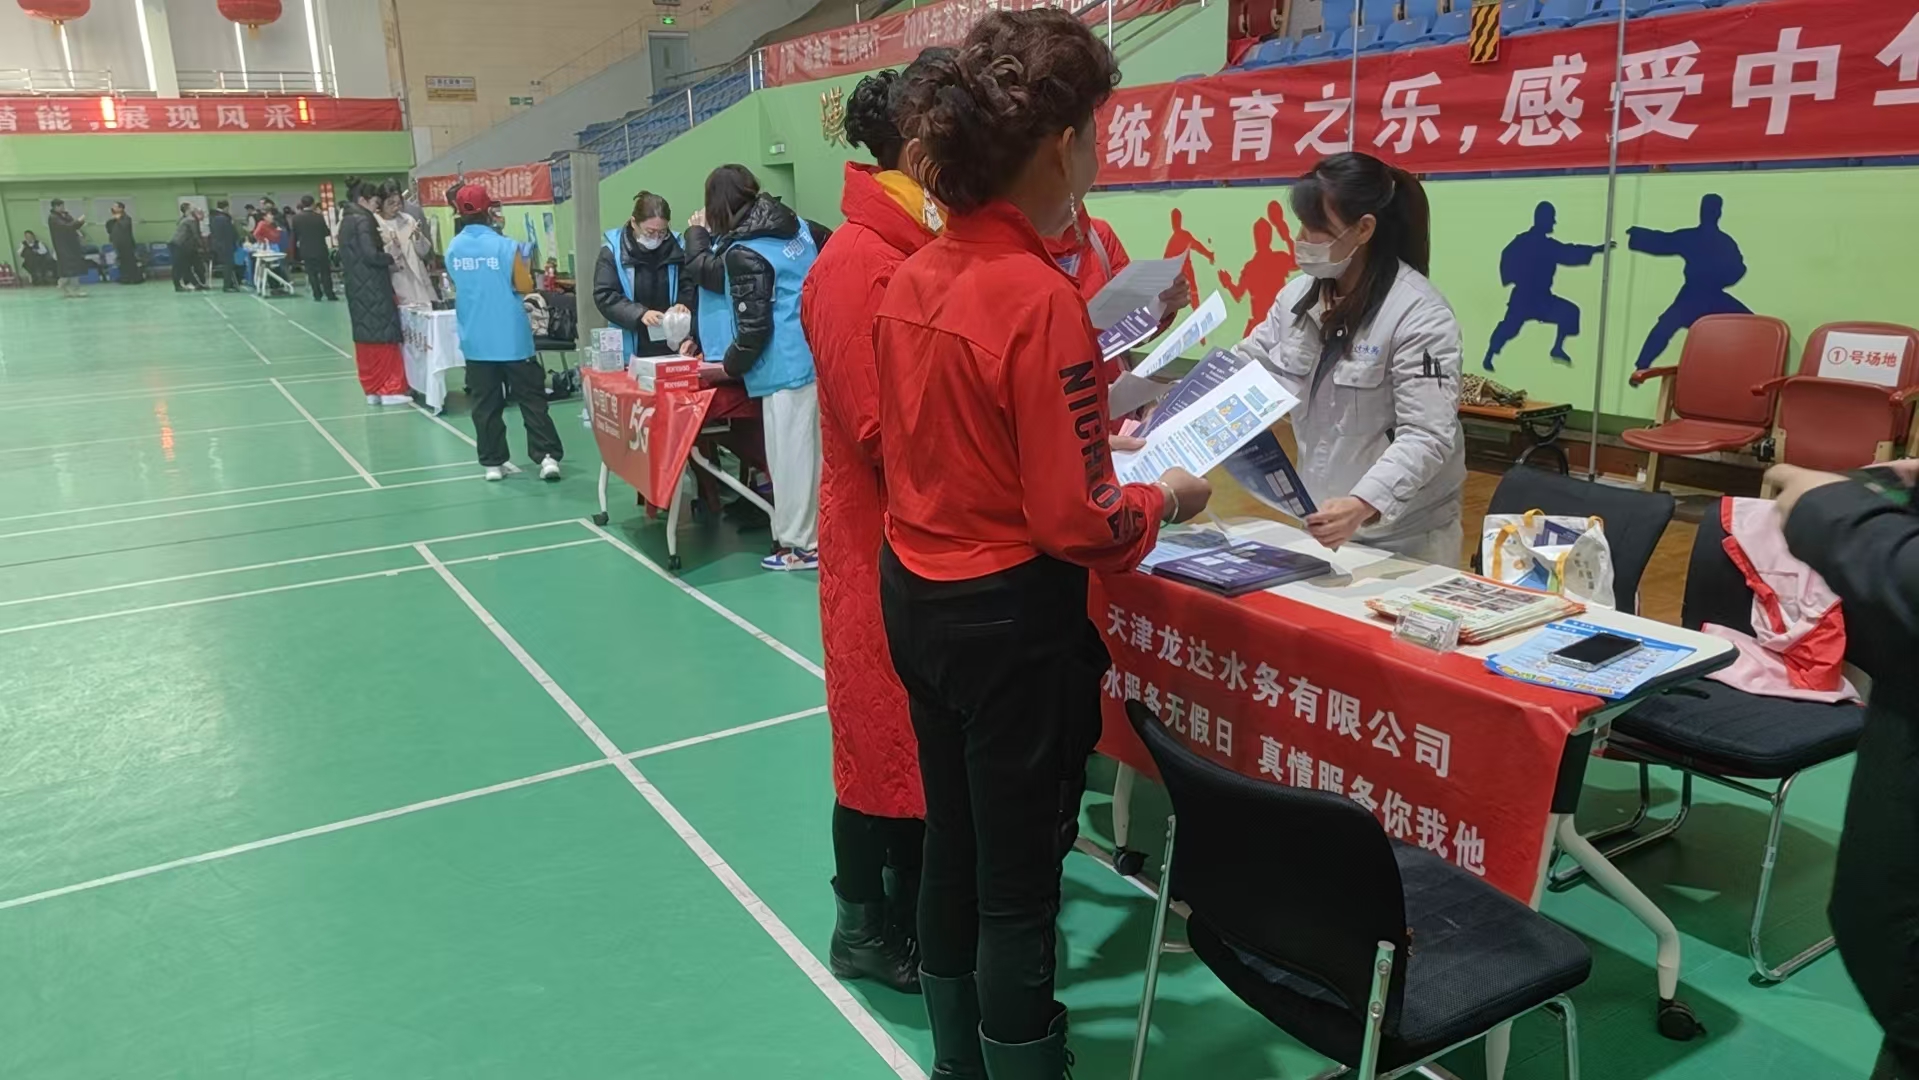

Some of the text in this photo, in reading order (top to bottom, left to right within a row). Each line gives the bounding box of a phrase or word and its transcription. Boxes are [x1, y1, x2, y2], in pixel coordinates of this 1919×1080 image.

[453, 257, 500, 271] 中国广电
[1106, 603, 1452, 778] 天津龙达水务有限公司
[1258, 734, 1487, 877] 真情服务你我他
